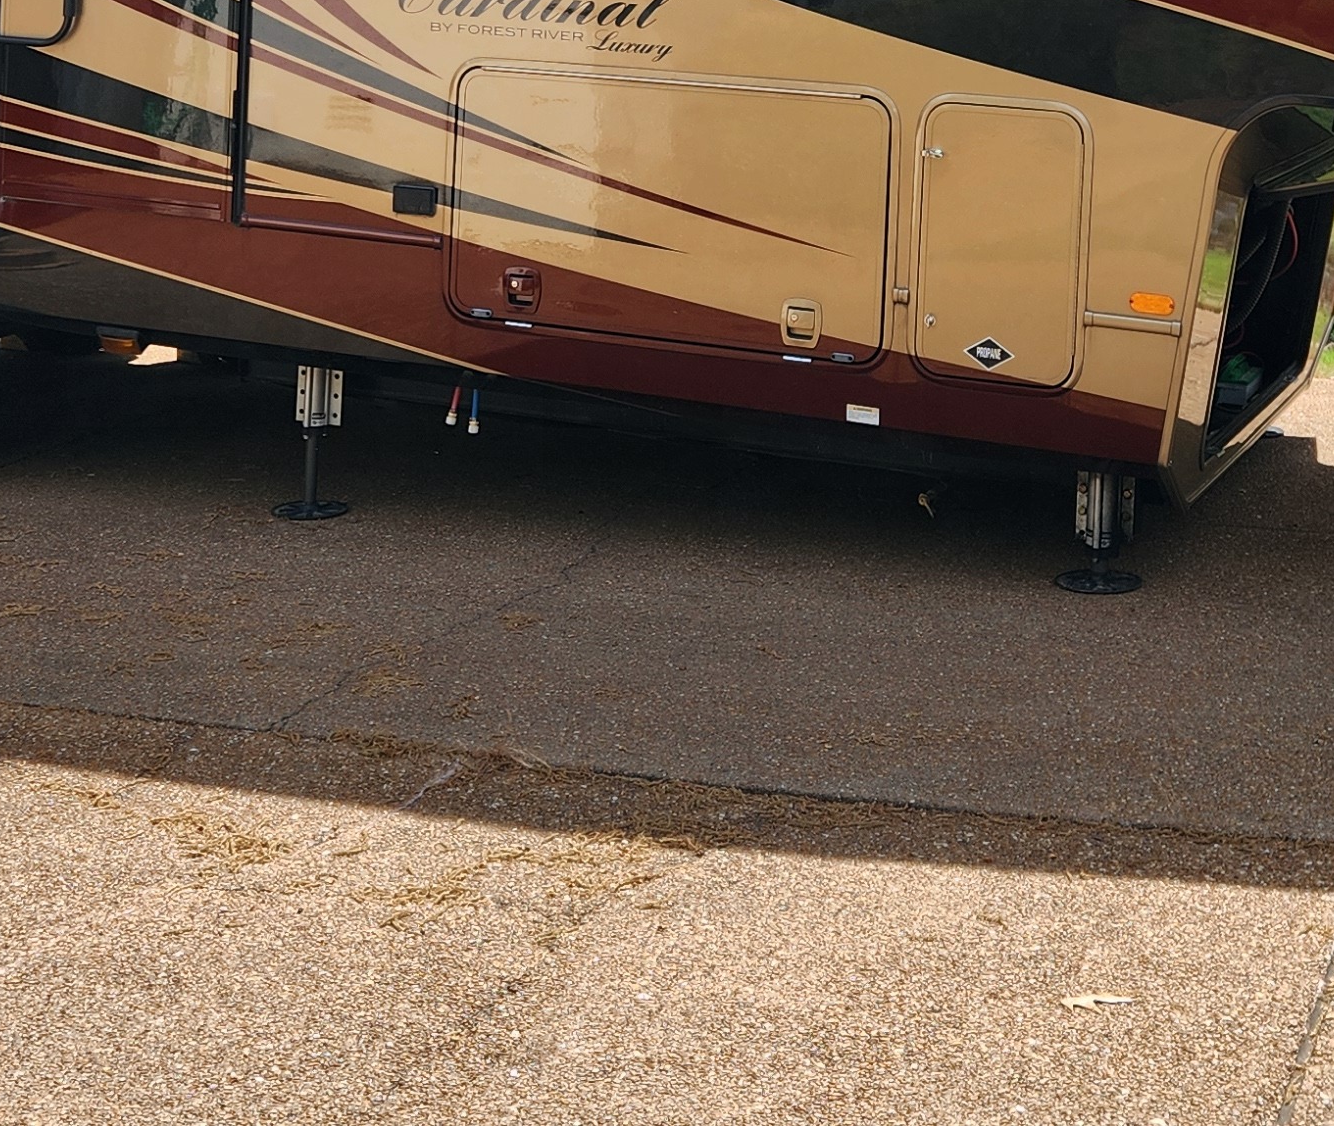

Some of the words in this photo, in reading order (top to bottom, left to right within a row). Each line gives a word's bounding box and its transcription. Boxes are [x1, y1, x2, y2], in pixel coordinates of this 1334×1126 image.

[430, 22, 453, 33] BY
[457, 24, 528, 38] FOREST
[531, 29, 584, 42] RIVER
[586, 29, 673, 62] Luxury
[976, 346, 1001, 360] PROPANE
